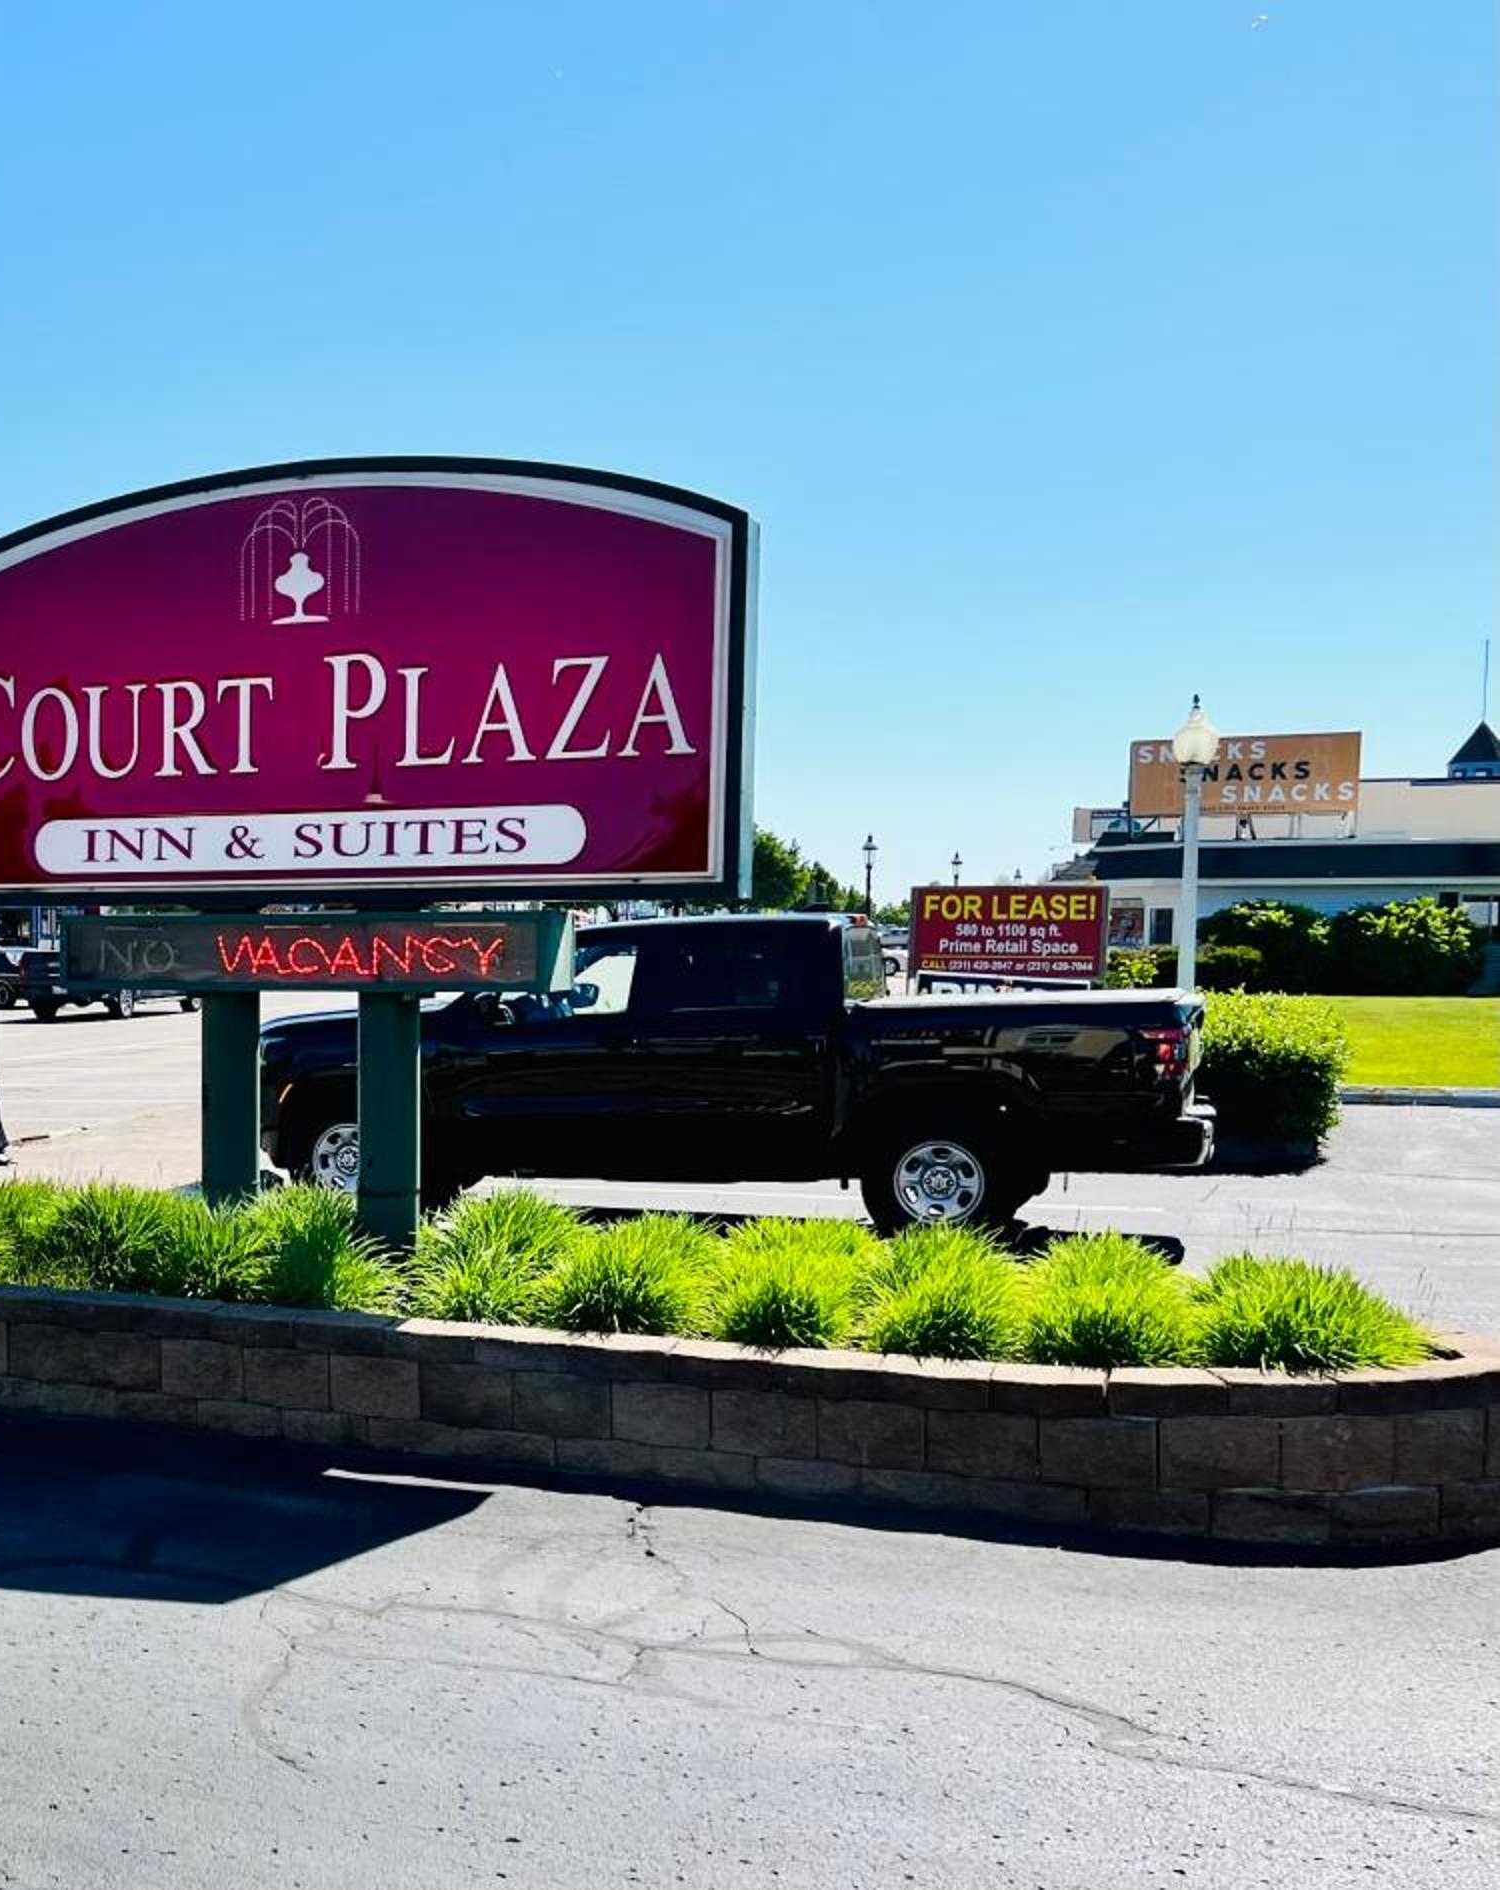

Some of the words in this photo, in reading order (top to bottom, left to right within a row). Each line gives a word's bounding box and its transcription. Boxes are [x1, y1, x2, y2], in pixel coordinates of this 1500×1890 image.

[321, 653, 696, 769] PLAZA
[1220, 782, 1355, 803] SNACKS
[83, 827, 196, 863] INN
[224, 825, 266, 860] &
[293, 817, 527, 859] SUITES
[924, 895, 982, 920] FOR
[991, 895, 1097, 920] LEASE!
[981, 925, 995, 937] to
[998, 923, 1027, 937] 1100
[1029, 926, 1046, 939] sq
[1049, 923, 1062, 937] ft.
[99, 939, 175, 974] NO
[216, 934, 503, 977] VACANCY
[939, 938, 981, 953] Prime
[985, 938, 1028, 953] Retail
[1031, 938, 1079, 957] Space
[921, 960, 946, 969] CALL
